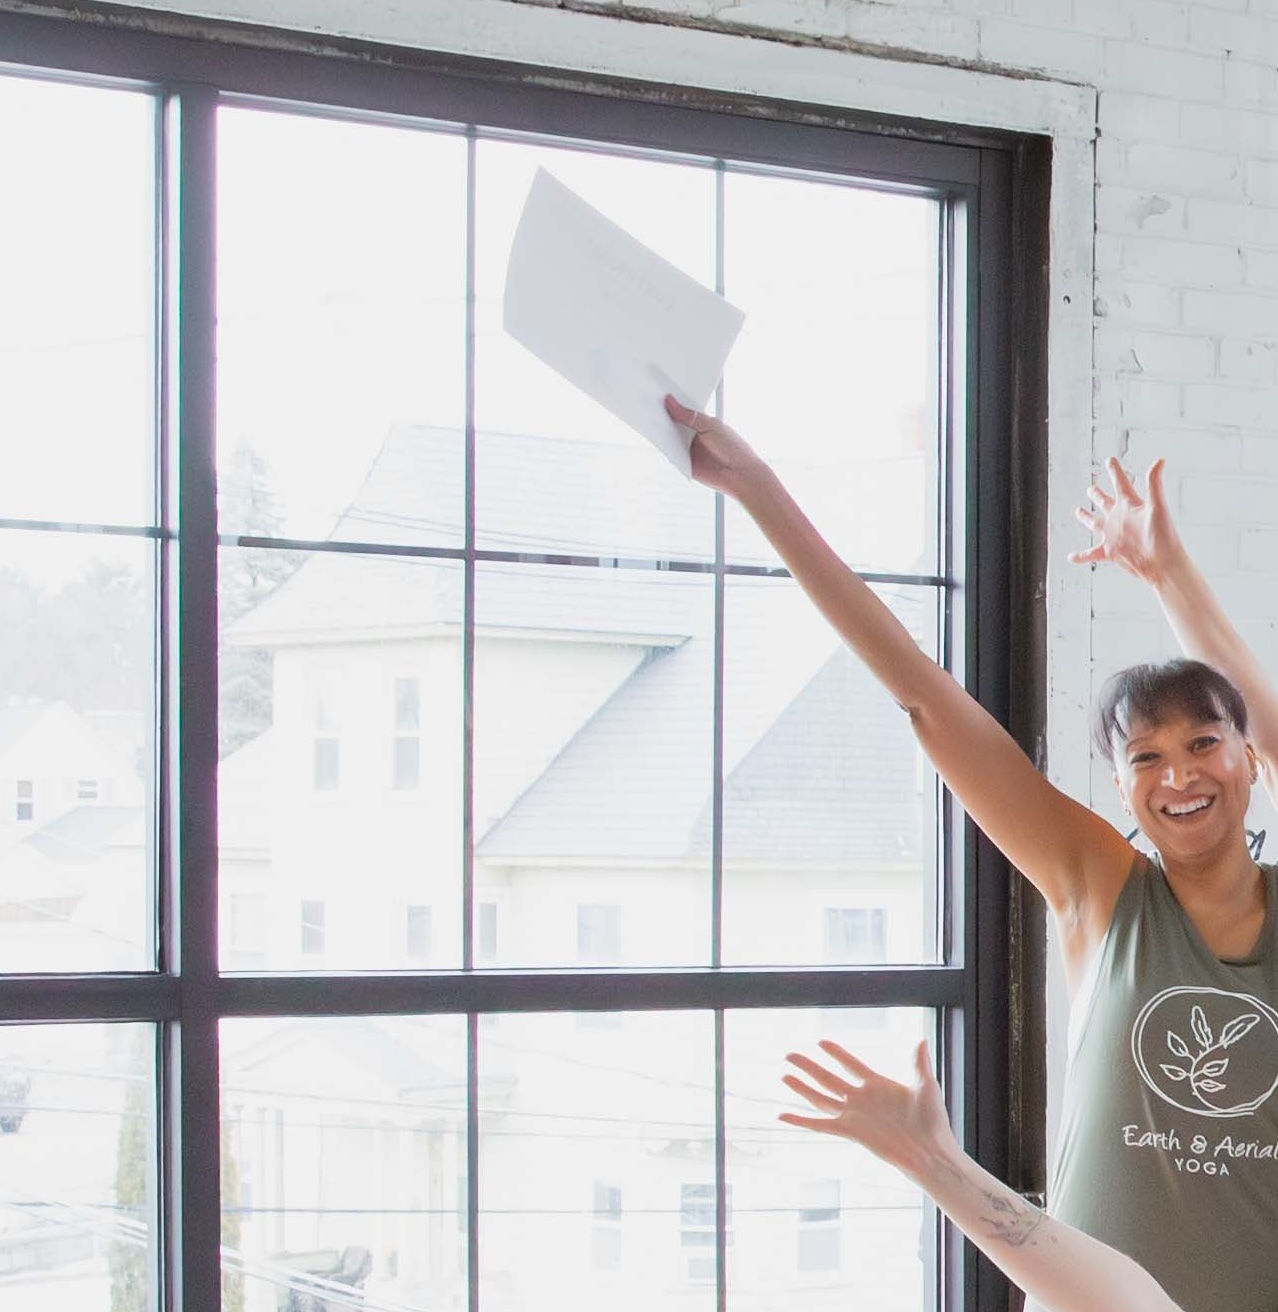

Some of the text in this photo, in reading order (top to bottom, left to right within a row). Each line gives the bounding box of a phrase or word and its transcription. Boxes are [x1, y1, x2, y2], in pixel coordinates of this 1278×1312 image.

[1121, 1124, 1181, 1151] Earth
[1190, 1134, 1208, 1154] &
[1175, 1158, 1230, 1176] YOGA
